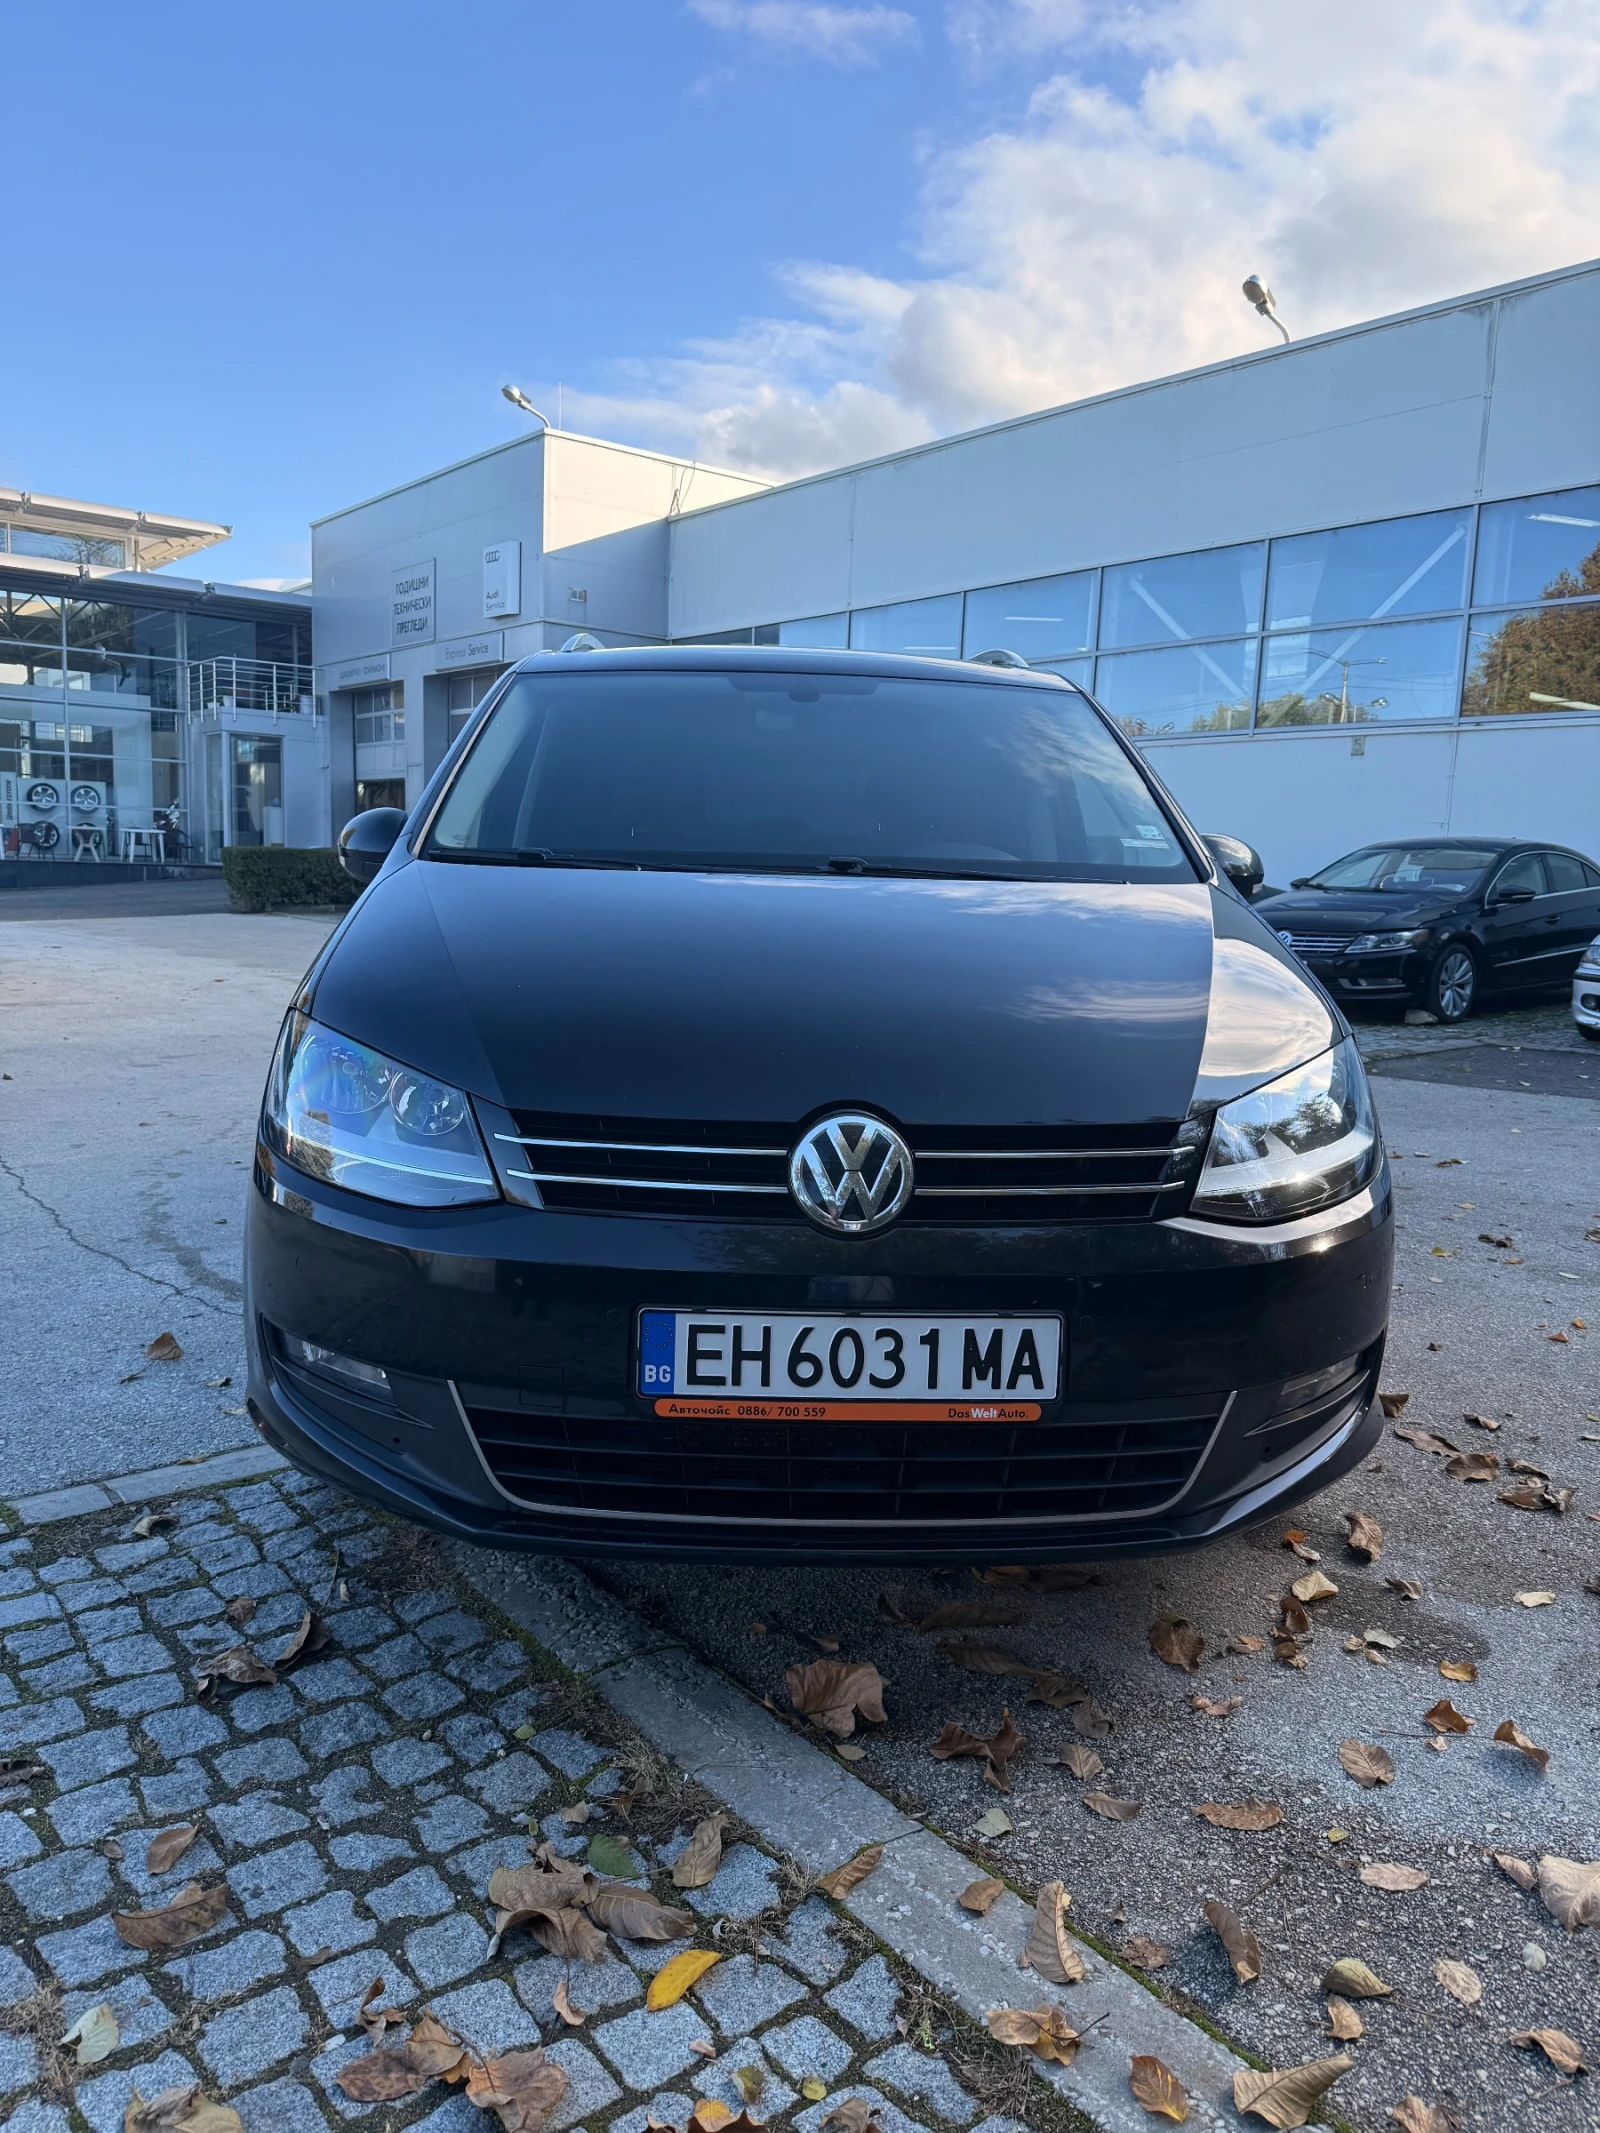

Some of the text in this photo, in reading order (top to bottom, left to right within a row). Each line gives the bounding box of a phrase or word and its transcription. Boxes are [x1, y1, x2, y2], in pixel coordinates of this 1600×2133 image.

[396, 575, 429, 596] ГОДИШНИ
[486, 590, 500, 600] Audi
[394, 595, 432, 616] ТЕХНИЧЕСКИ
[486, 601, 505, 611] Service
[396, 617, 428, 634] ПРЕГЛЕДИ
[445, 643, 489, 662] Express Service
[644, 1365, 671, 1383] BG
[669, 1404, 730, 1416] Авточойс
[778, 1407, 800, 1417] 700
[803, 1408, 827, 1418] 559
